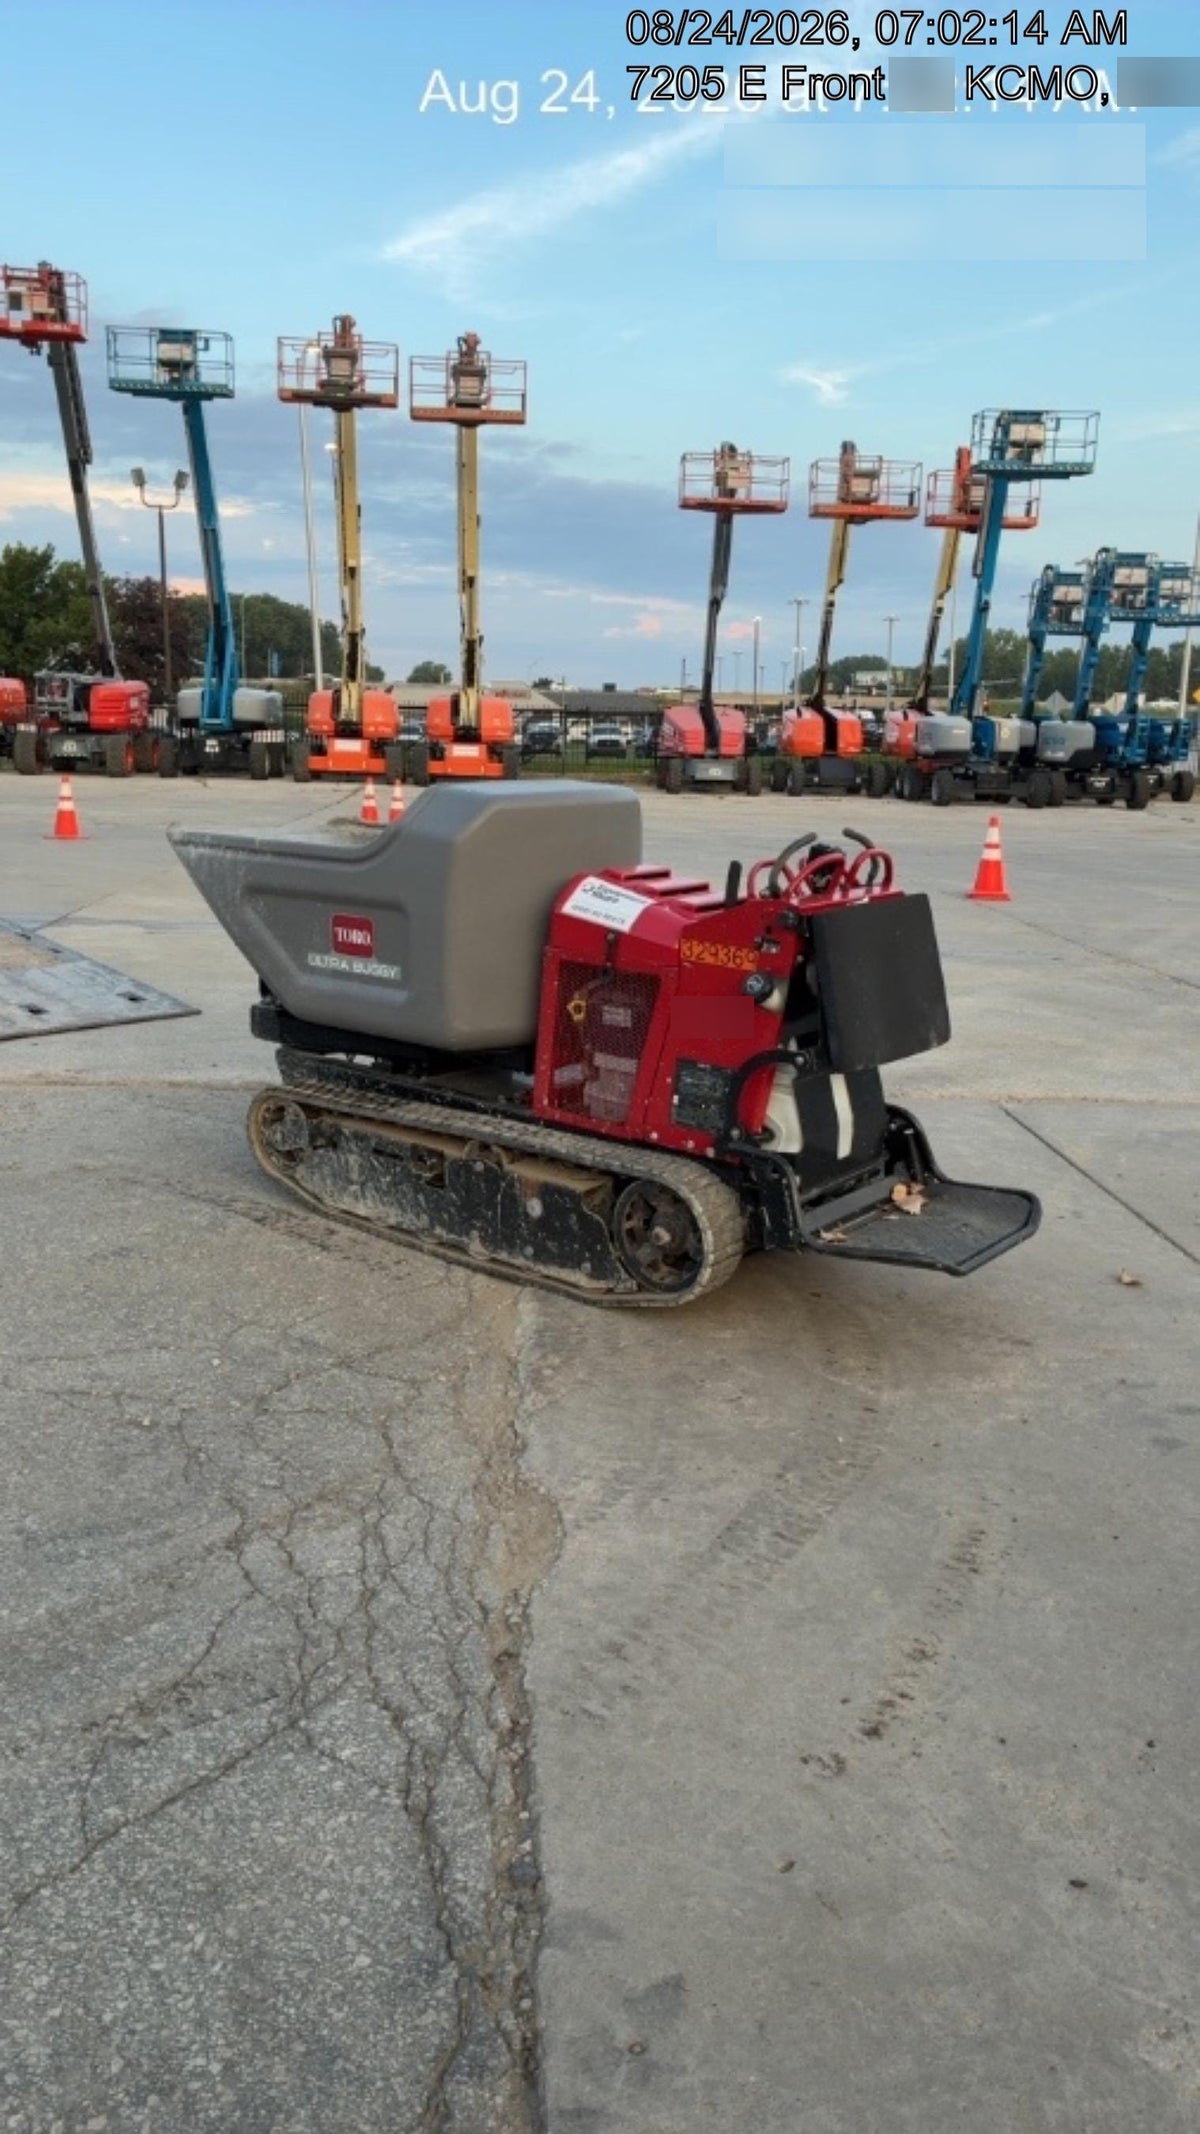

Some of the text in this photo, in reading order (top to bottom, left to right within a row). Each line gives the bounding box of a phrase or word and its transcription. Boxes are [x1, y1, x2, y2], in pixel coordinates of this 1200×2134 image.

[334, 926, 372, 946] TORO
[307, 952, 400, 980] ULTRA BUGGY
